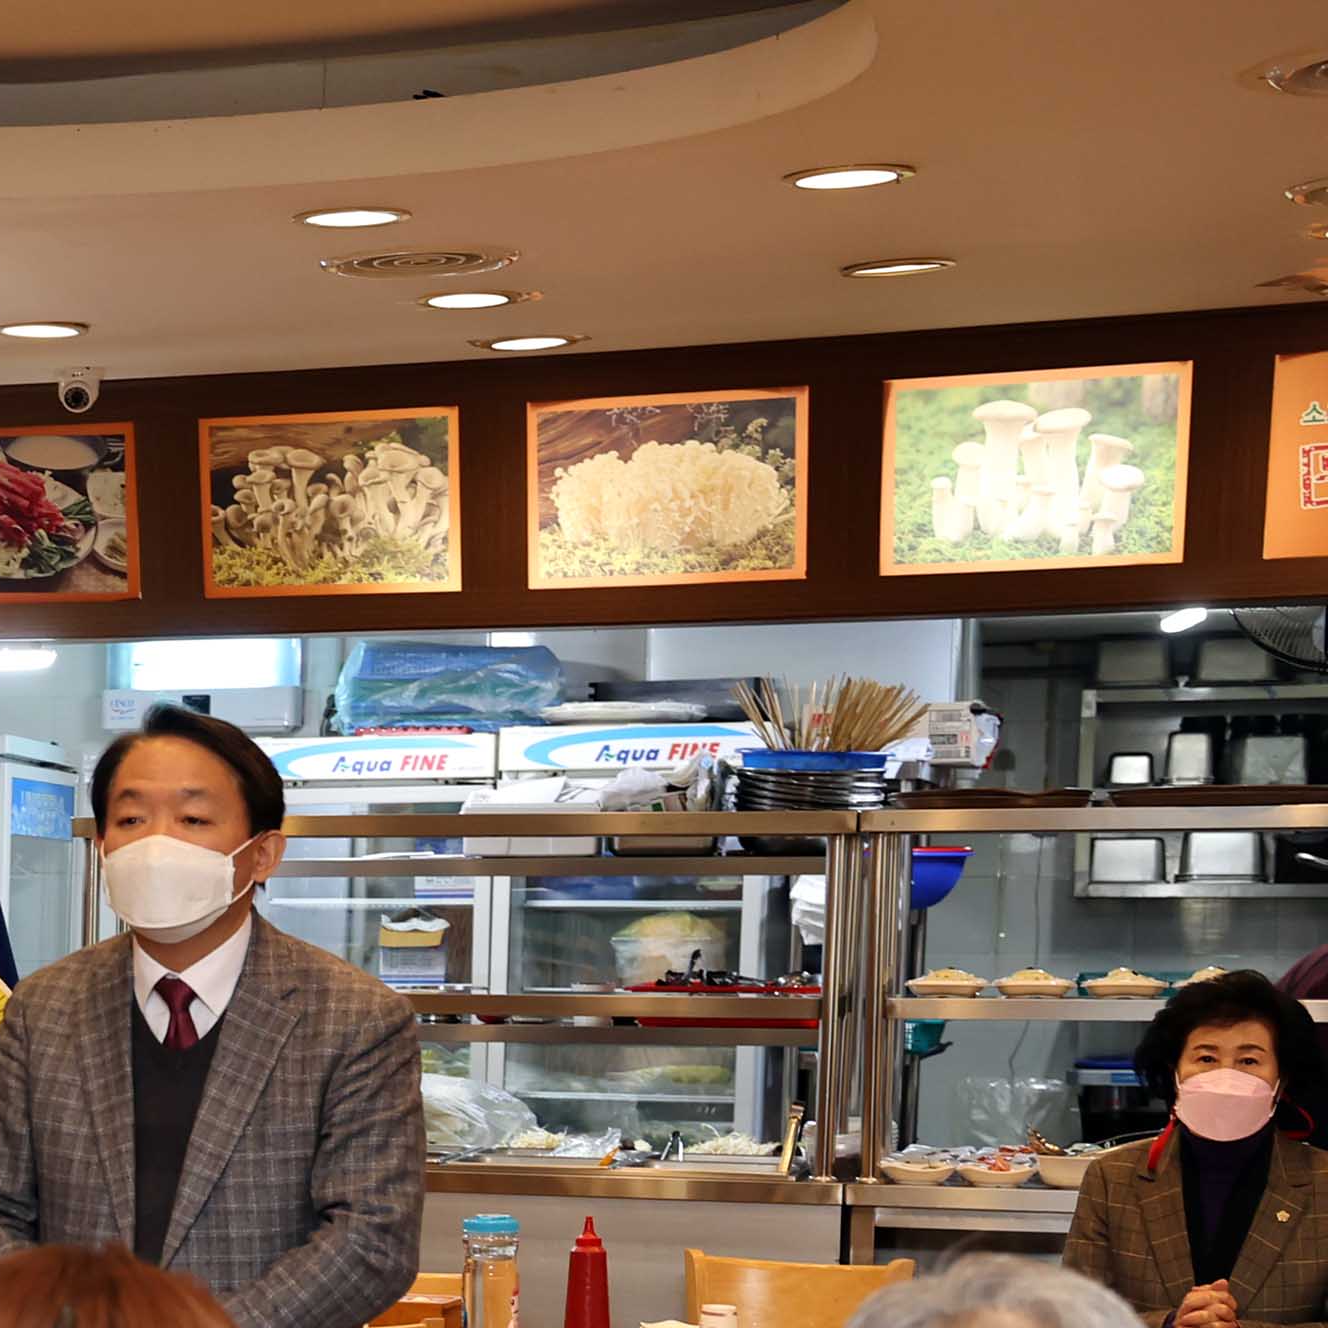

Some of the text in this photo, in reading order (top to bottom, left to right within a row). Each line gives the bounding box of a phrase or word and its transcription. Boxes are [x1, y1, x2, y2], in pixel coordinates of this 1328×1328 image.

[332, 754, 449, 775] Aqua FINE
[596, 745, 660, 765] Aqua
